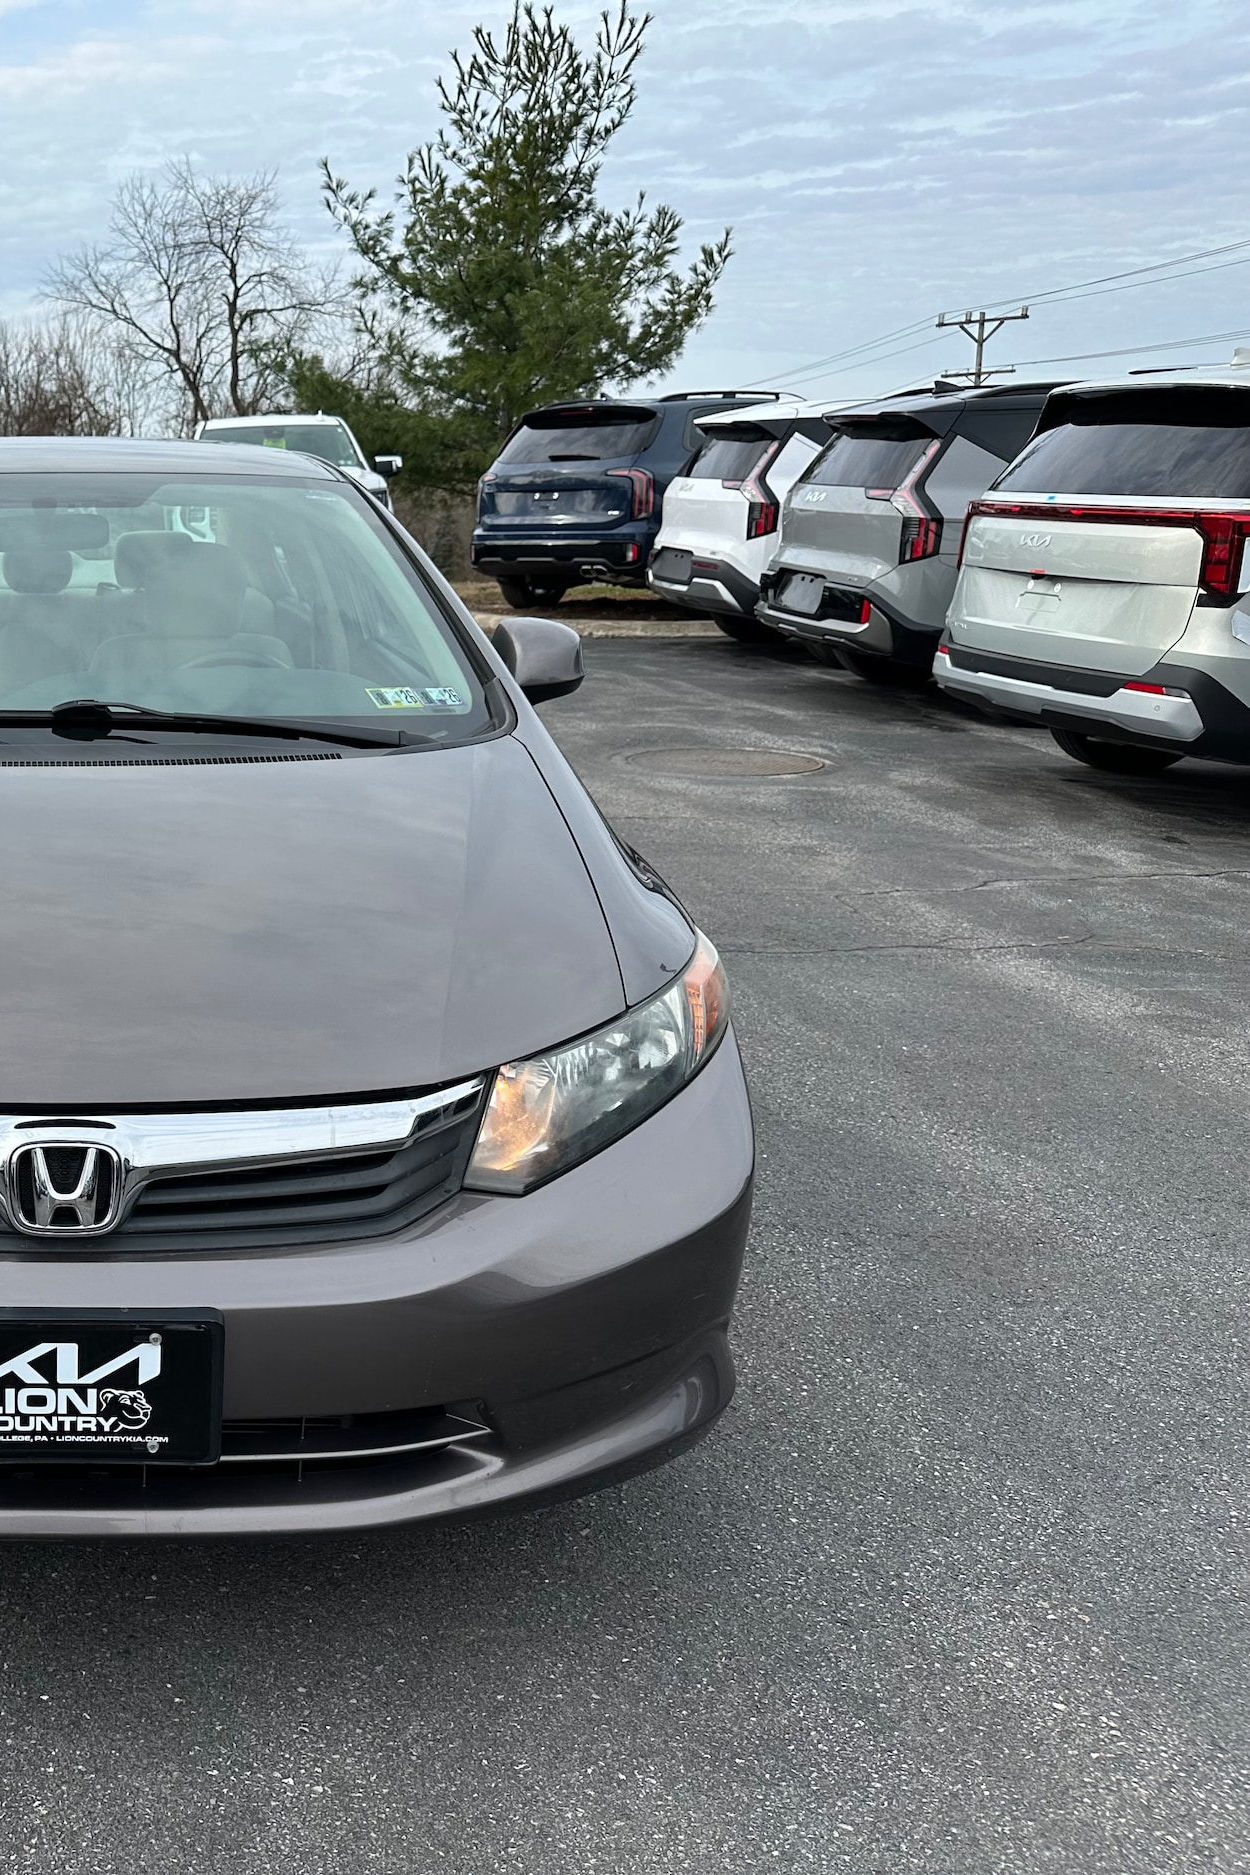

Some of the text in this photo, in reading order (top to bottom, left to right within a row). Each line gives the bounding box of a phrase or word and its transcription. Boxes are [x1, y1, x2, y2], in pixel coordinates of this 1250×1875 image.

[805, 491, 827, 501] KIA
[1020, 534, 1052, 548] KIA
[399, 689, 418, 704] 26
[443, 689, 462, 703] 26
[34, 1435, 49, 1443] PA
[56, 1435, 169, 1443] LIONCOUNTRYKIA.COM
